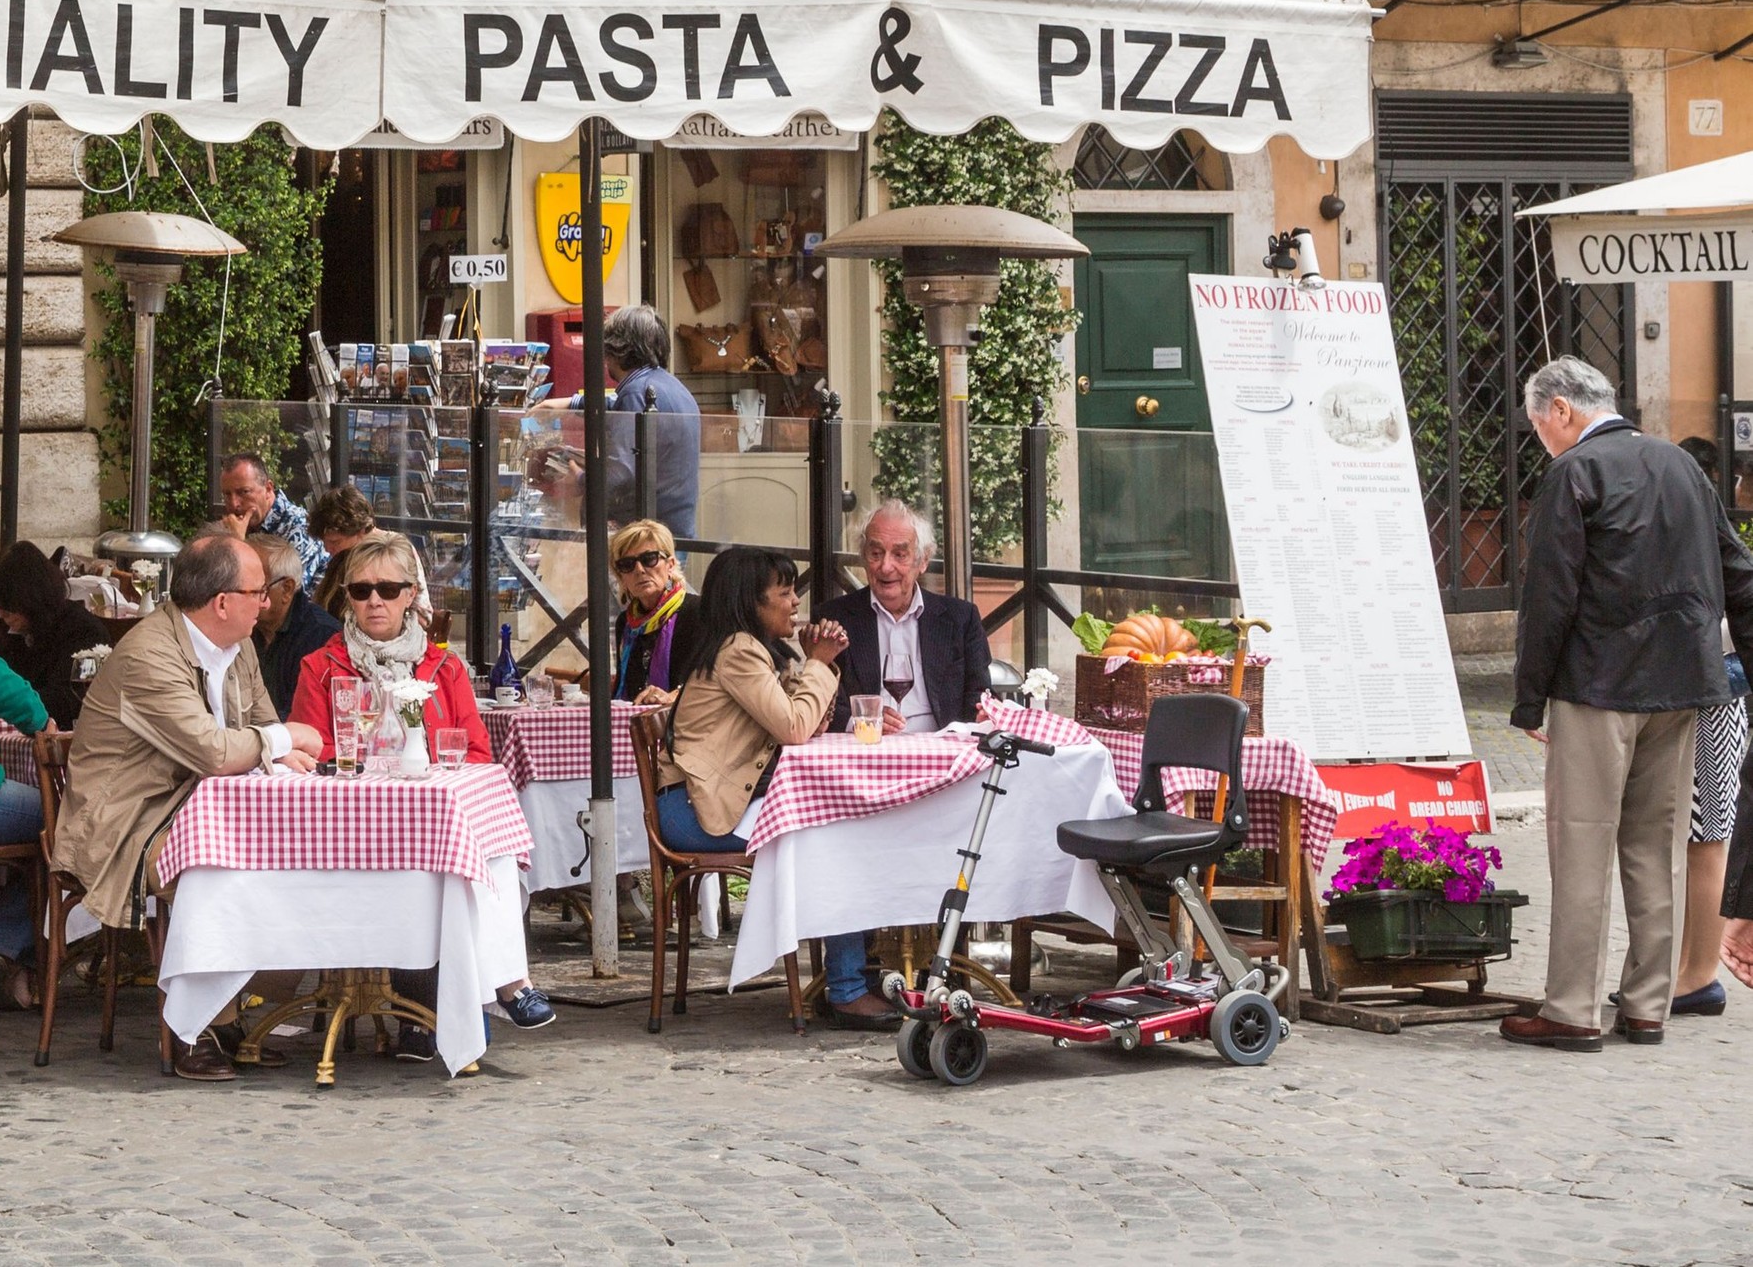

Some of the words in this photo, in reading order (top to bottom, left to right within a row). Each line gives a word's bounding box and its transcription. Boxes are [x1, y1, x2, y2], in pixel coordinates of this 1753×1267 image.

[463, 12, 793, 104] PASTA
[870, 5, 926, 96] &
[1038, 22, 1293, 122] PIZZA
[1694, 106, 1717, 130] 77
[1579, 229, 1749, 276] COCKTAIL
[451, 260, 462, 277] €
[466, 259, 505, 279] 0,50
[1196, 283, 1228, 309] NO
[1233, 285, 1319, 312] FROZEN
[1324, 289, 1383, 315] FOOD
[1282, 317, 1347, 343] Welcome
[1349, 330, 1362, 342] to
[1317, 345, 1393, 375] Panzirone
[1343, 791, 1375, 812] EVERY
[1376, 789, 1396, 811] DAY
[1437, 780, 1454, 797] NO
[1408, 801, 1446, 817] BREAD
[1446, 800, 1486, 816] CHARG
